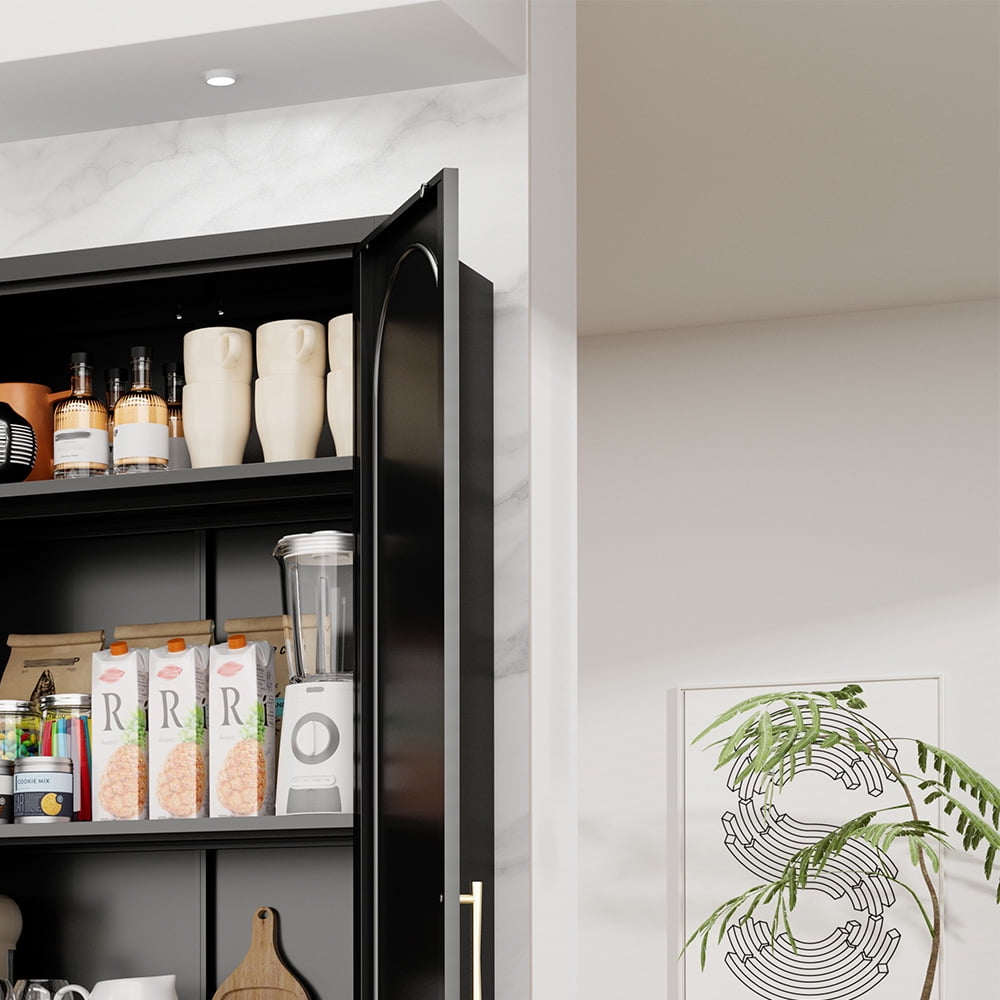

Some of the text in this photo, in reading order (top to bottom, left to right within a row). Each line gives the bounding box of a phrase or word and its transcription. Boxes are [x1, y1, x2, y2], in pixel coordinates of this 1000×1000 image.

[102, 692, 126, 731] R
[160, 690, 184, 729] R
[220, 687, 244, 726] R
